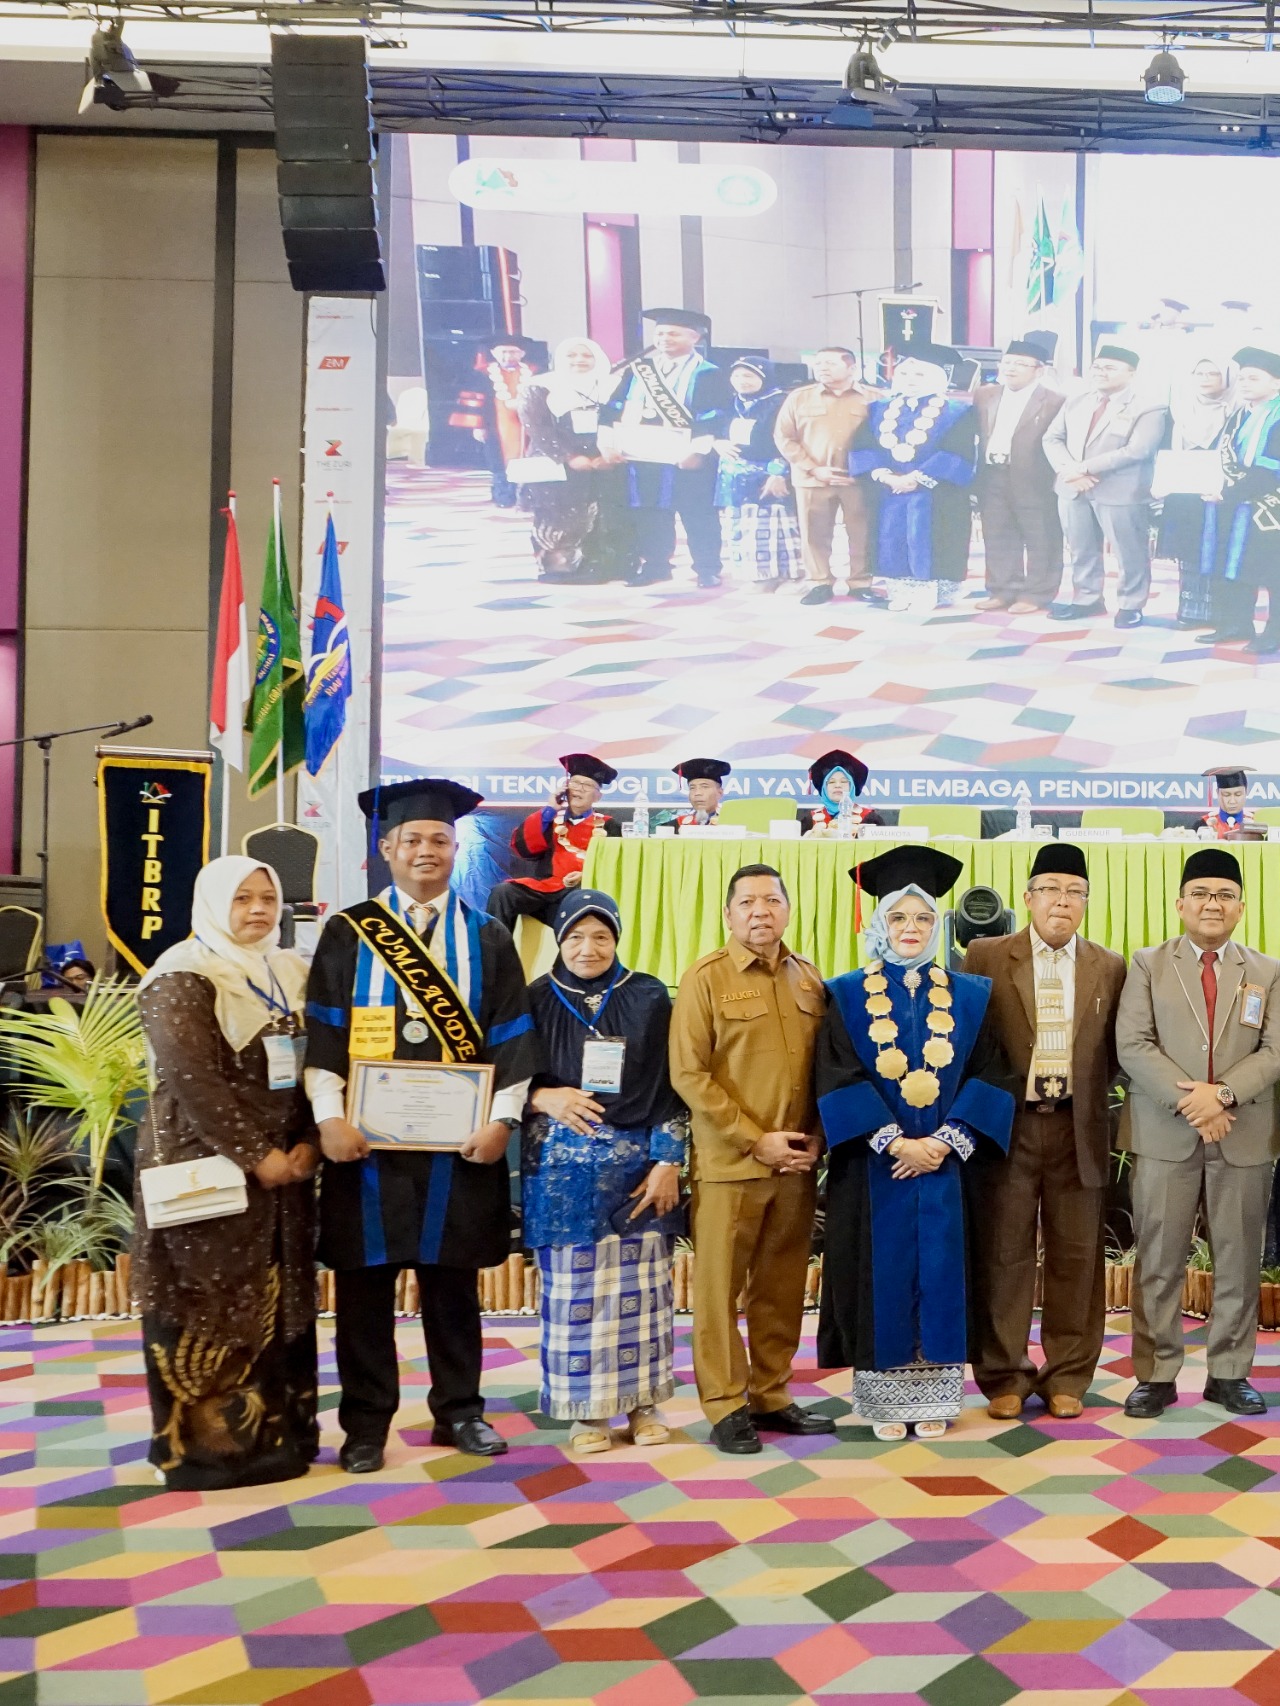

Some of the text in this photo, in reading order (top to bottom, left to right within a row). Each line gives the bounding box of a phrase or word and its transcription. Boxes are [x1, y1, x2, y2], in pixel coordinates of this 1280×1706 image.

[899, 778, 1032, 798] LEMBAGA
[1040, 780, 1204, 799] PENDIDIKAN
[140, 808, 164, 940] ITBRP
[360, 917, 477, 1062] CUMLAUDE
